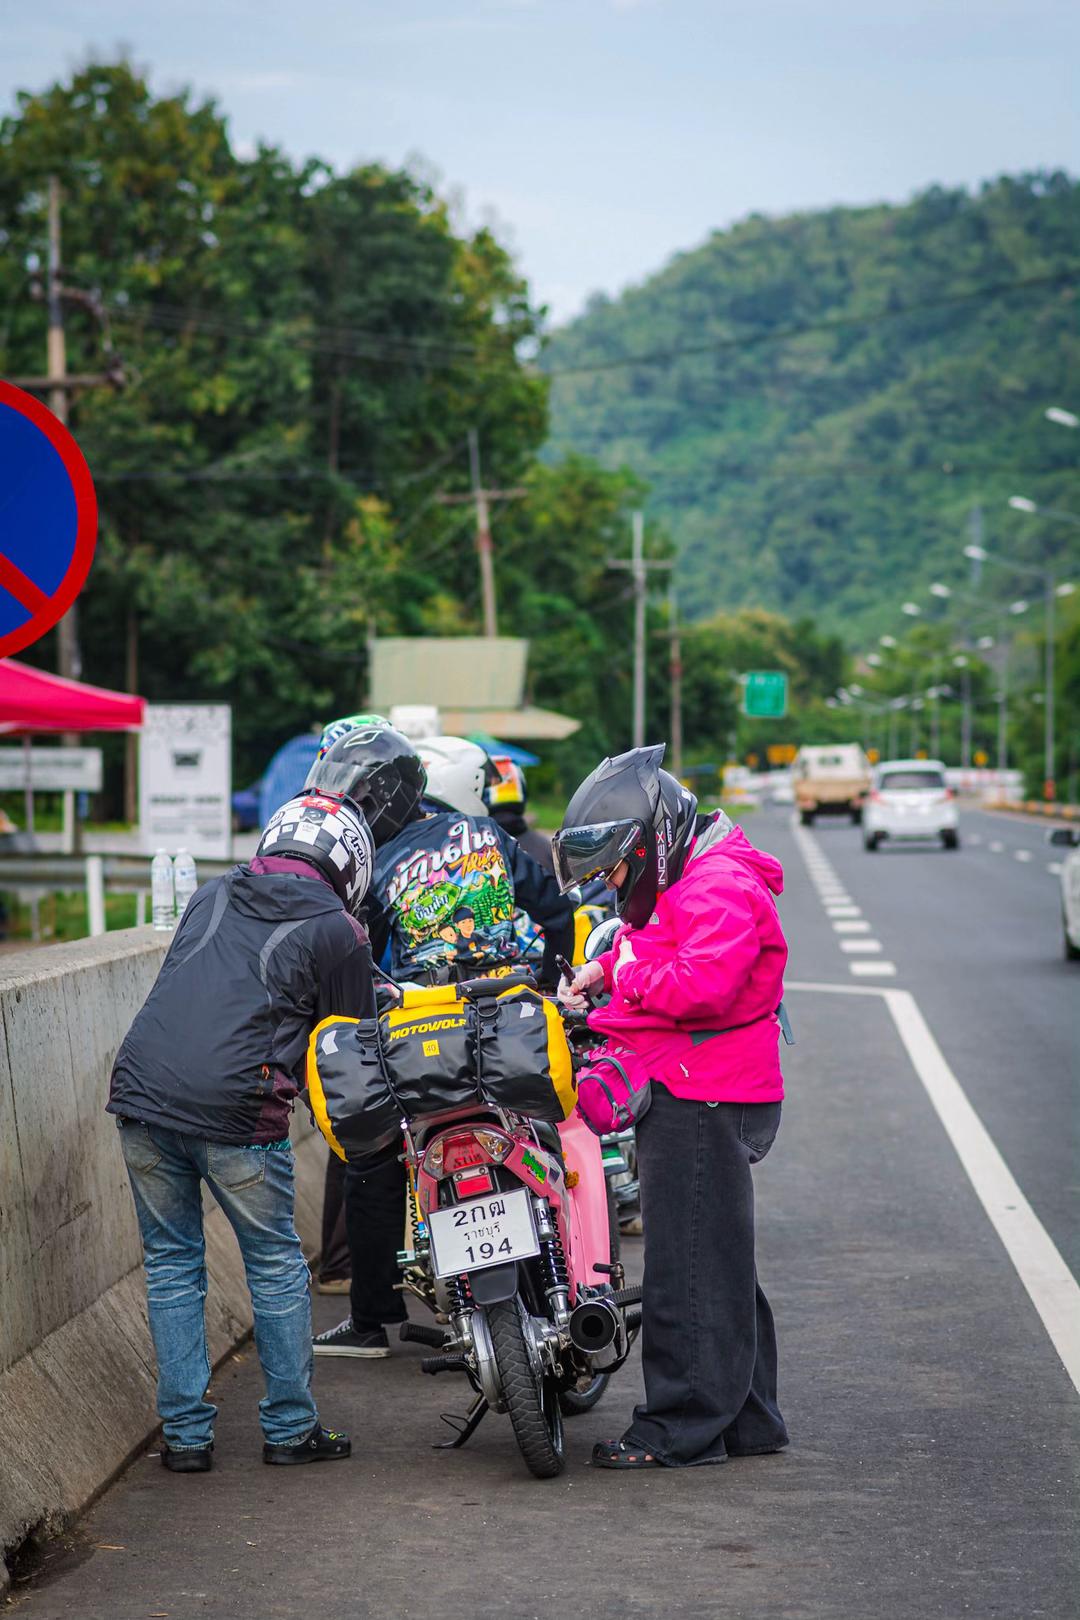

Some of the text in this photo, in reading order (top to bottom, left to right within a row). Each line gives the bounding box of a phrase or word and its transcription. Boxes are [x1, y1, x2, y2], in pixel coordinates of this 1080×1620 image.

[344, 832, 367, 861] Arai
[656, 831, 665, 885] INDEX
[452, 1199, 506, 1228] 2กฒ
[463, 1221, 501, 1241] ราชบุรี
[465, 1237, 513, 1263] 194
